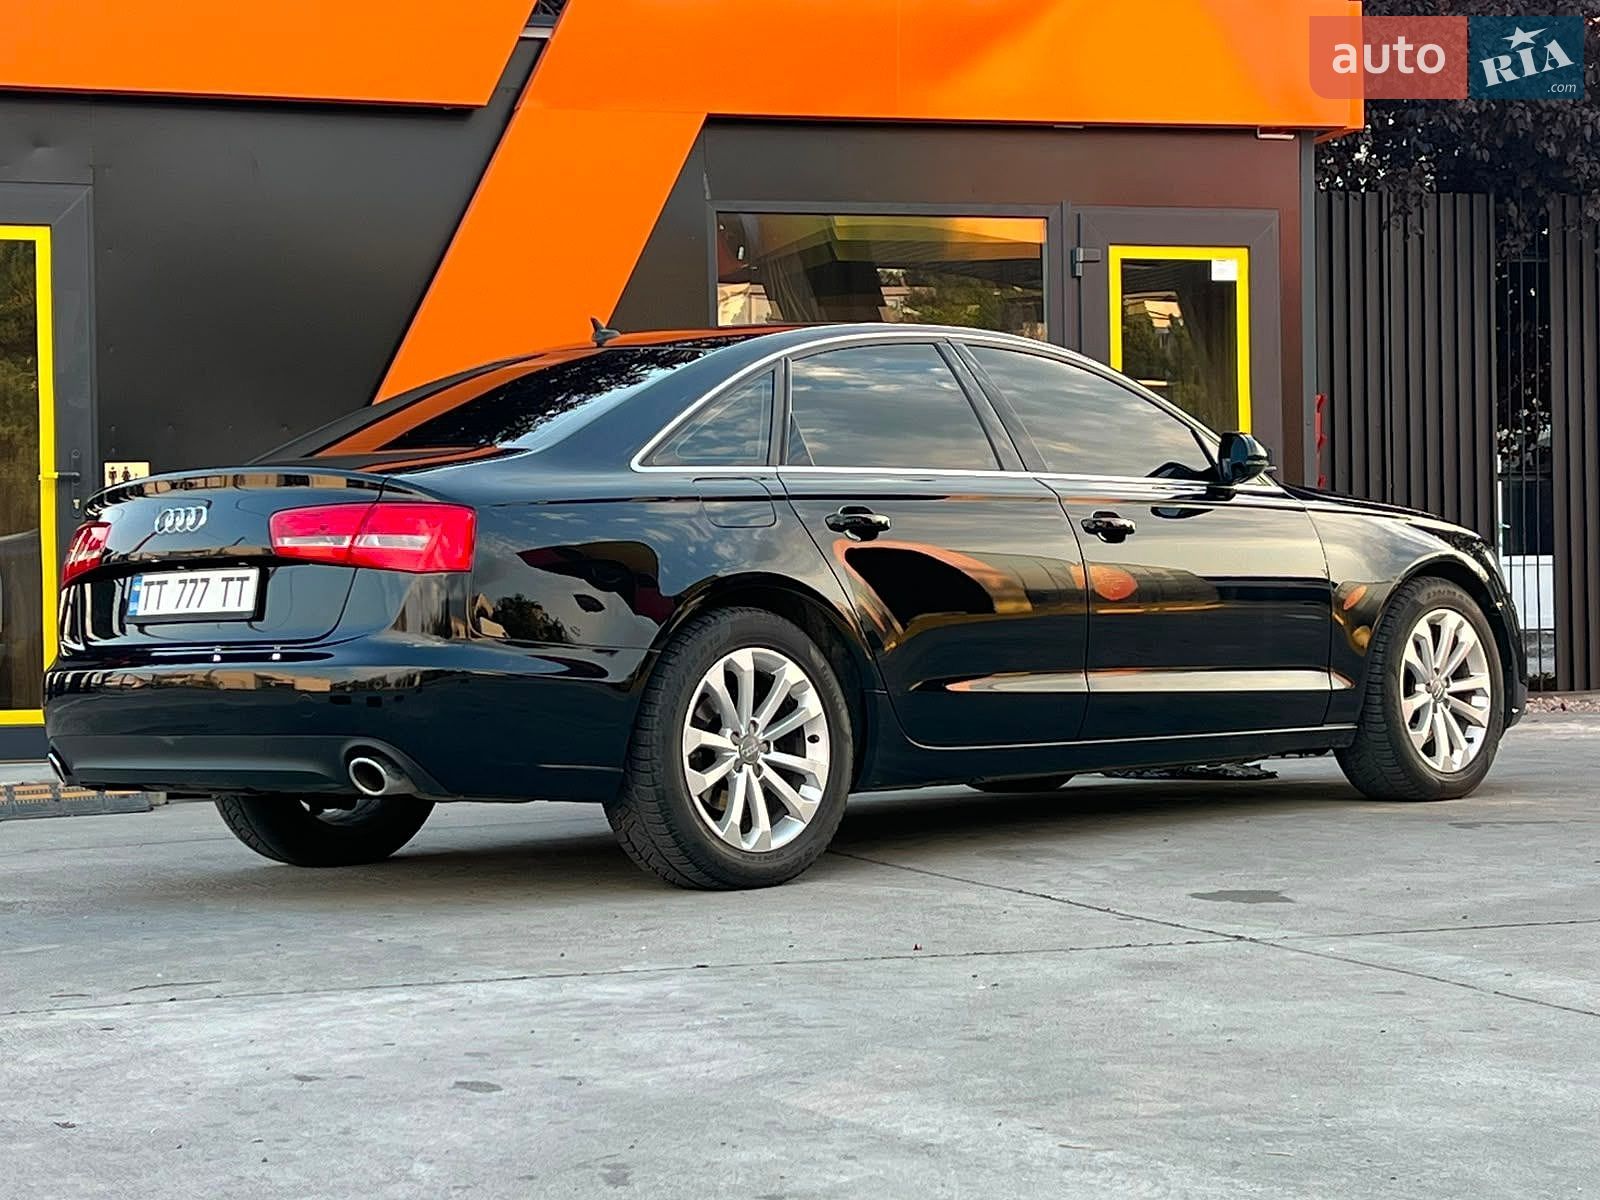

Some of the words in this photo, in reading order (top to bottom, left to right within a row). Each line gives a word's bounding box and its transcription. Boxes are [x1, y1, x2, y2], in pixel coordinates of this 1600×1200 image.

[143, 580, 168, 611] TT
[175, 578, 210, 609] 777
[221, 576, 250, 607] TT
